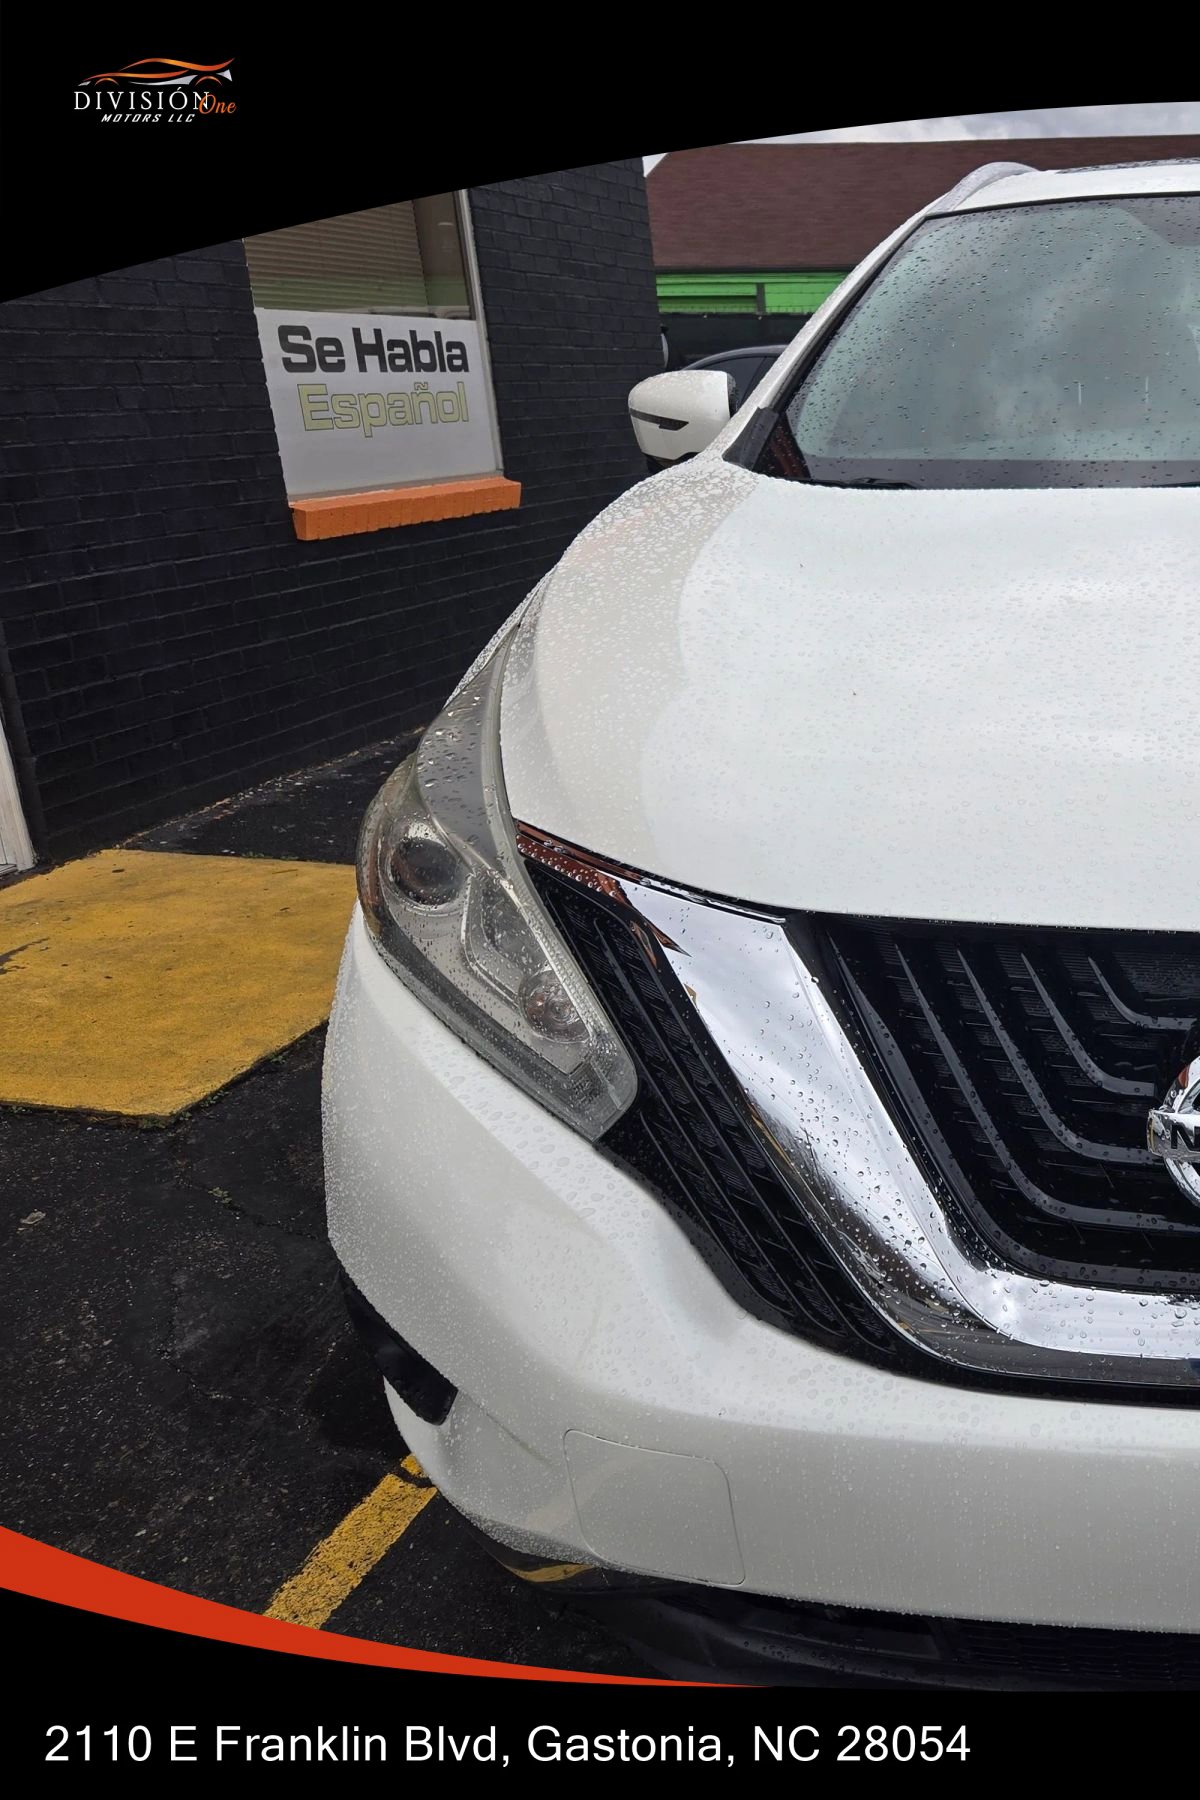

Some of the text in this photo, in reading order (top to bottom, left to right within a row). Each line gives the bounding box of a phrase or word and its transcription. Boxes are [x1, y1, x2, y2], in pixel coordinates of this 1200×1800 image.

[277, 325, 470, 373] Se Habla
[297, 381, 470, 438] Español
